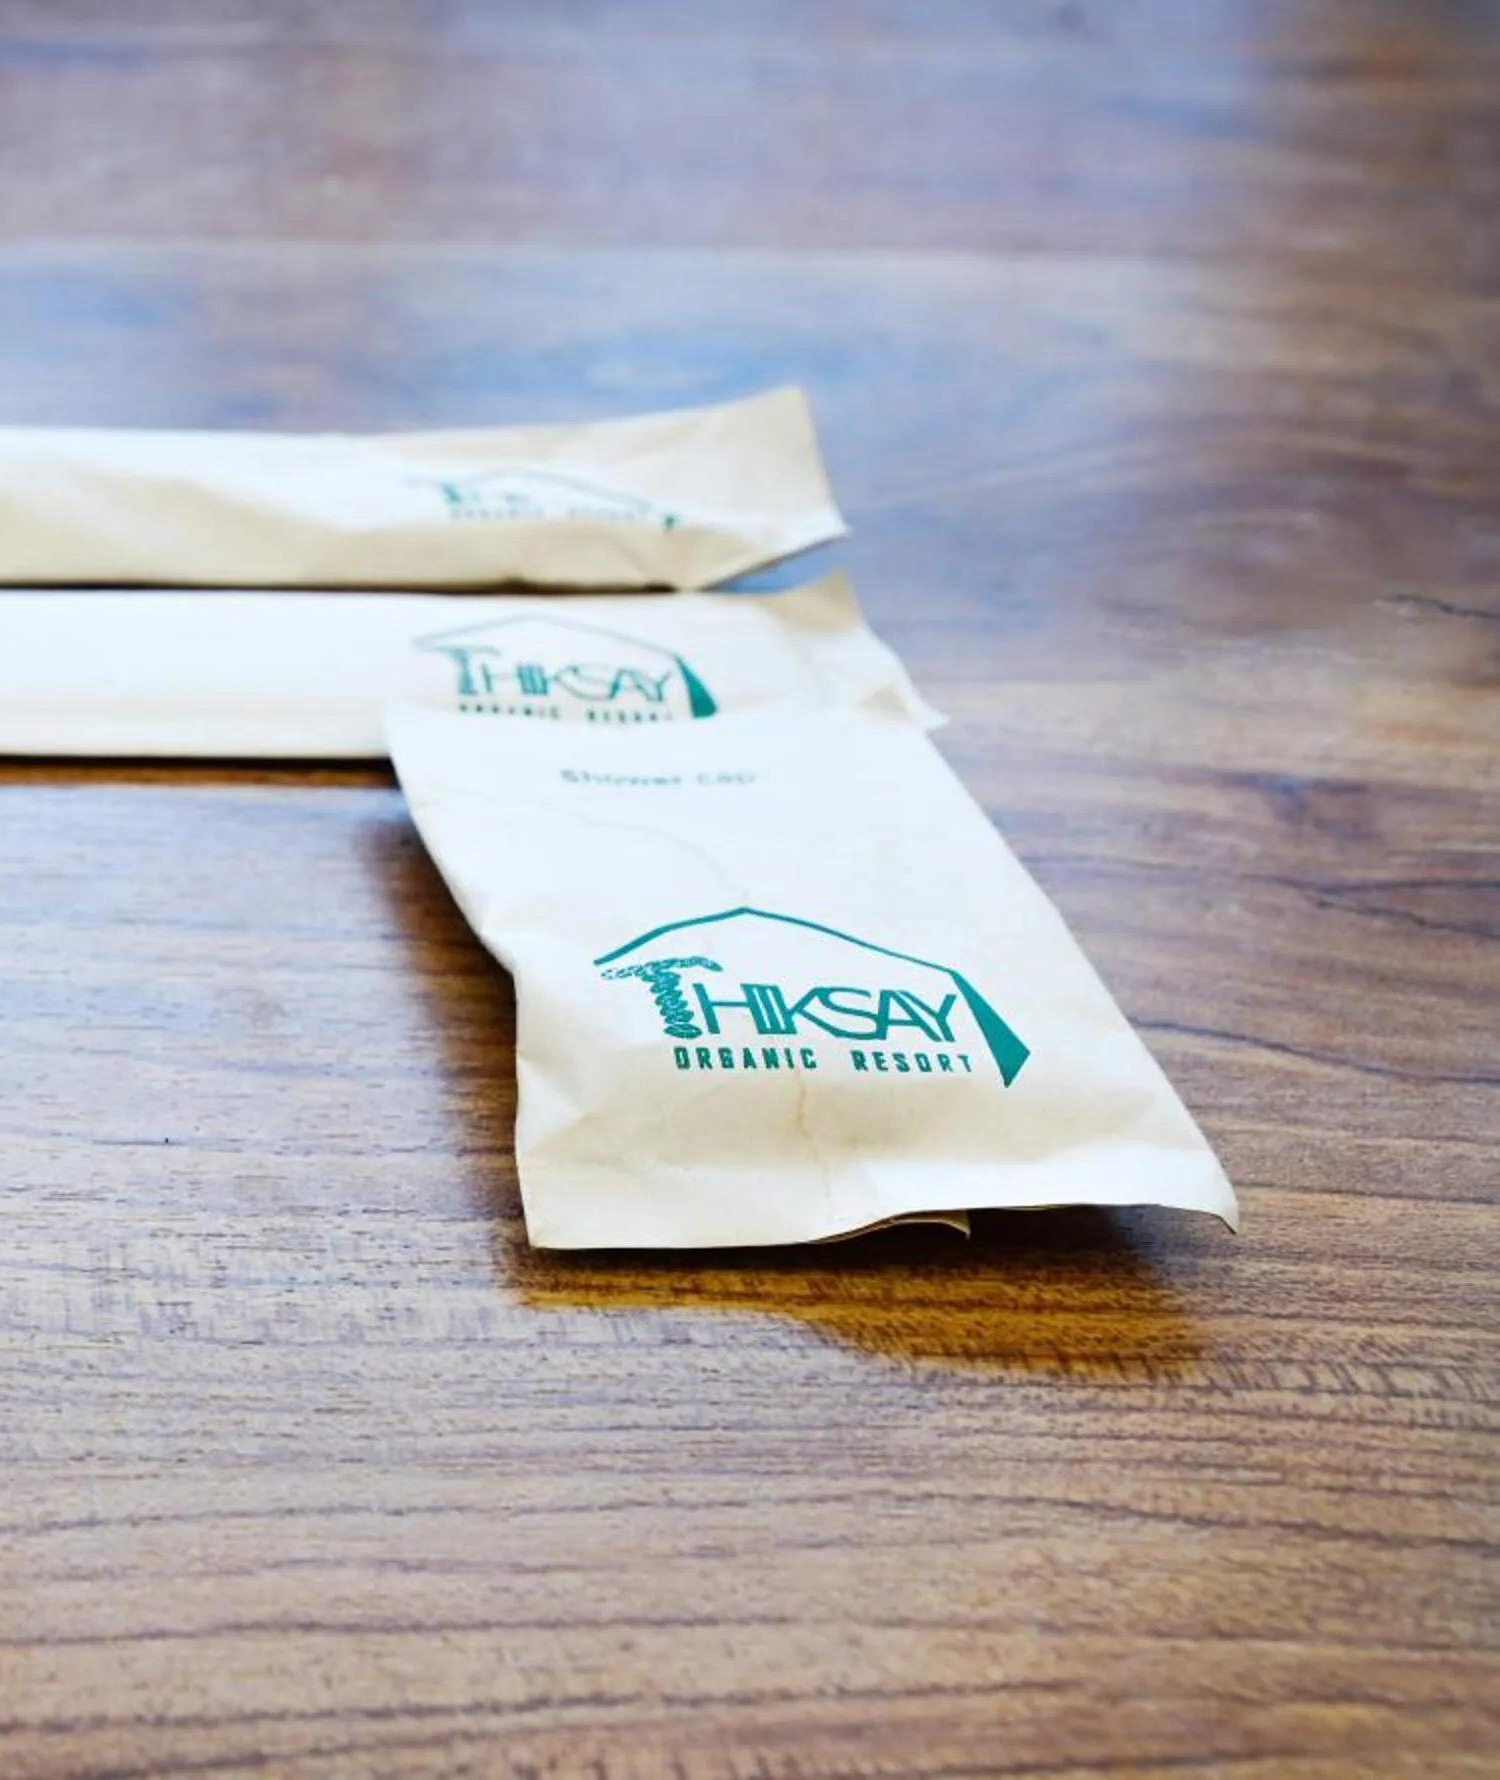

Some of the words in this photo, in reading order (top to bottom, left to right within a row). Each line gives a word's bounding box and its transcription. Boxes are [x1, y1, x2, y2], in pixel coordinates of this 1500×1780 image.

[601, 956, 958, 1043] THIKSAY
[673, 1046, 818, 1070] ORGANIC
[852, 1050, 973, 1073] RESORT
